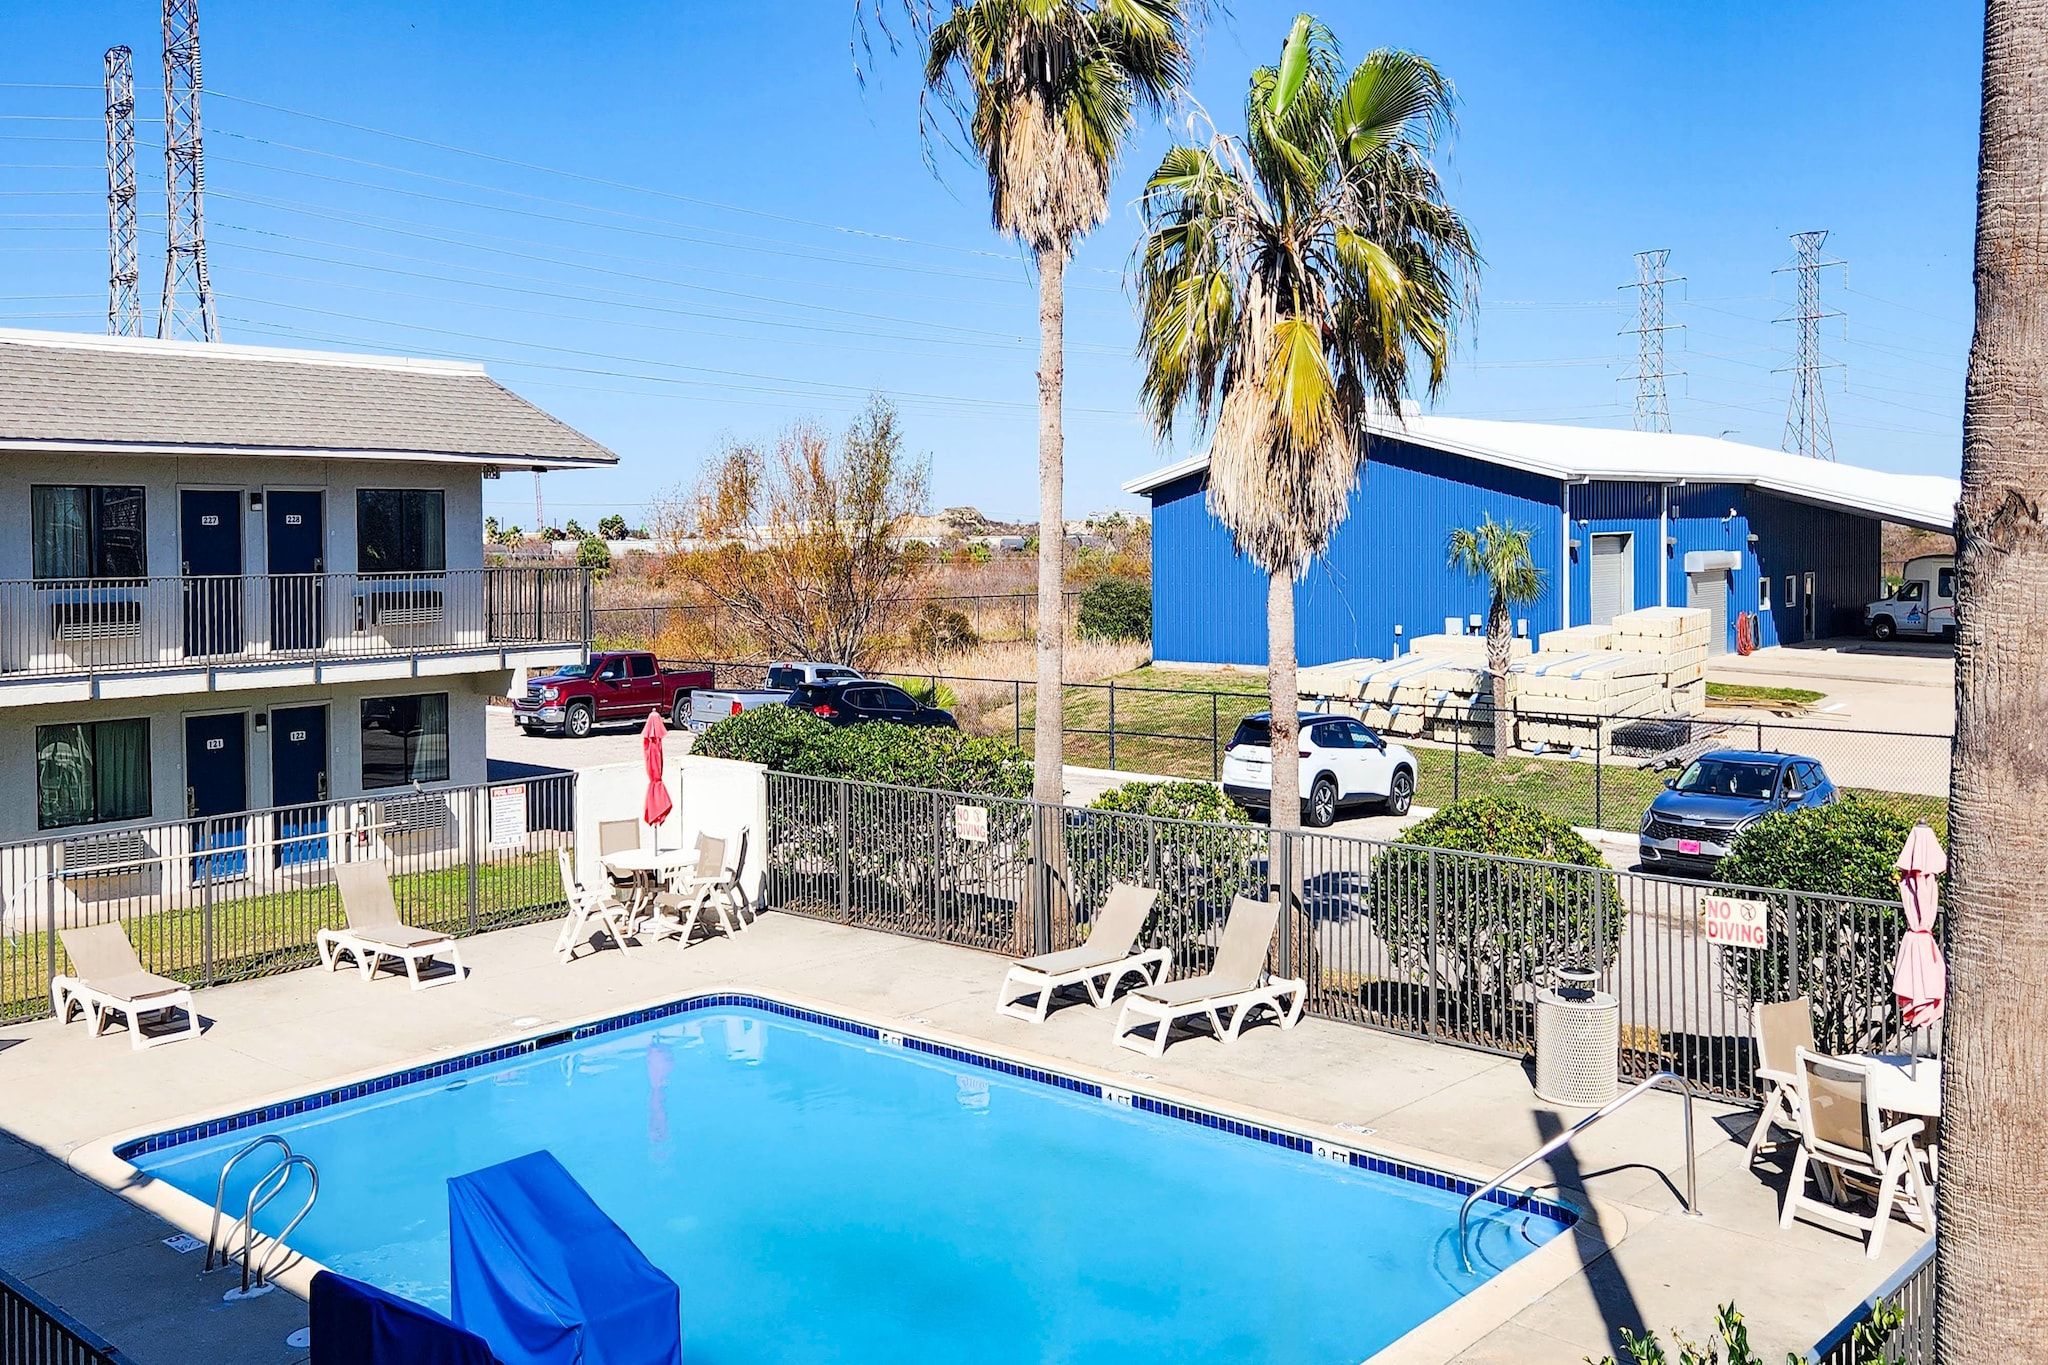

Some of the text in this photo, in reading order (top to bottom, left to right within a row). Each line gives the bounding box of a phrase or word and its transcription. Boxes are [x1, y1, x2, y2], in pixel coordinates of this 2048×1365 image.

[203, 516, 218, 524] 227
[287, 515, 301, 524] 228
[292, 731, 305, 740] 122
[209, 739, 223, 748] 121
[956, 808, 969, 822] NO
[957, 822, 986, 838] DIVING
[1708, 900, 1731, 919] NO
[1708, 920, 1765, 945] DIVING
[1332, 1151, 1348, 1163] FT
